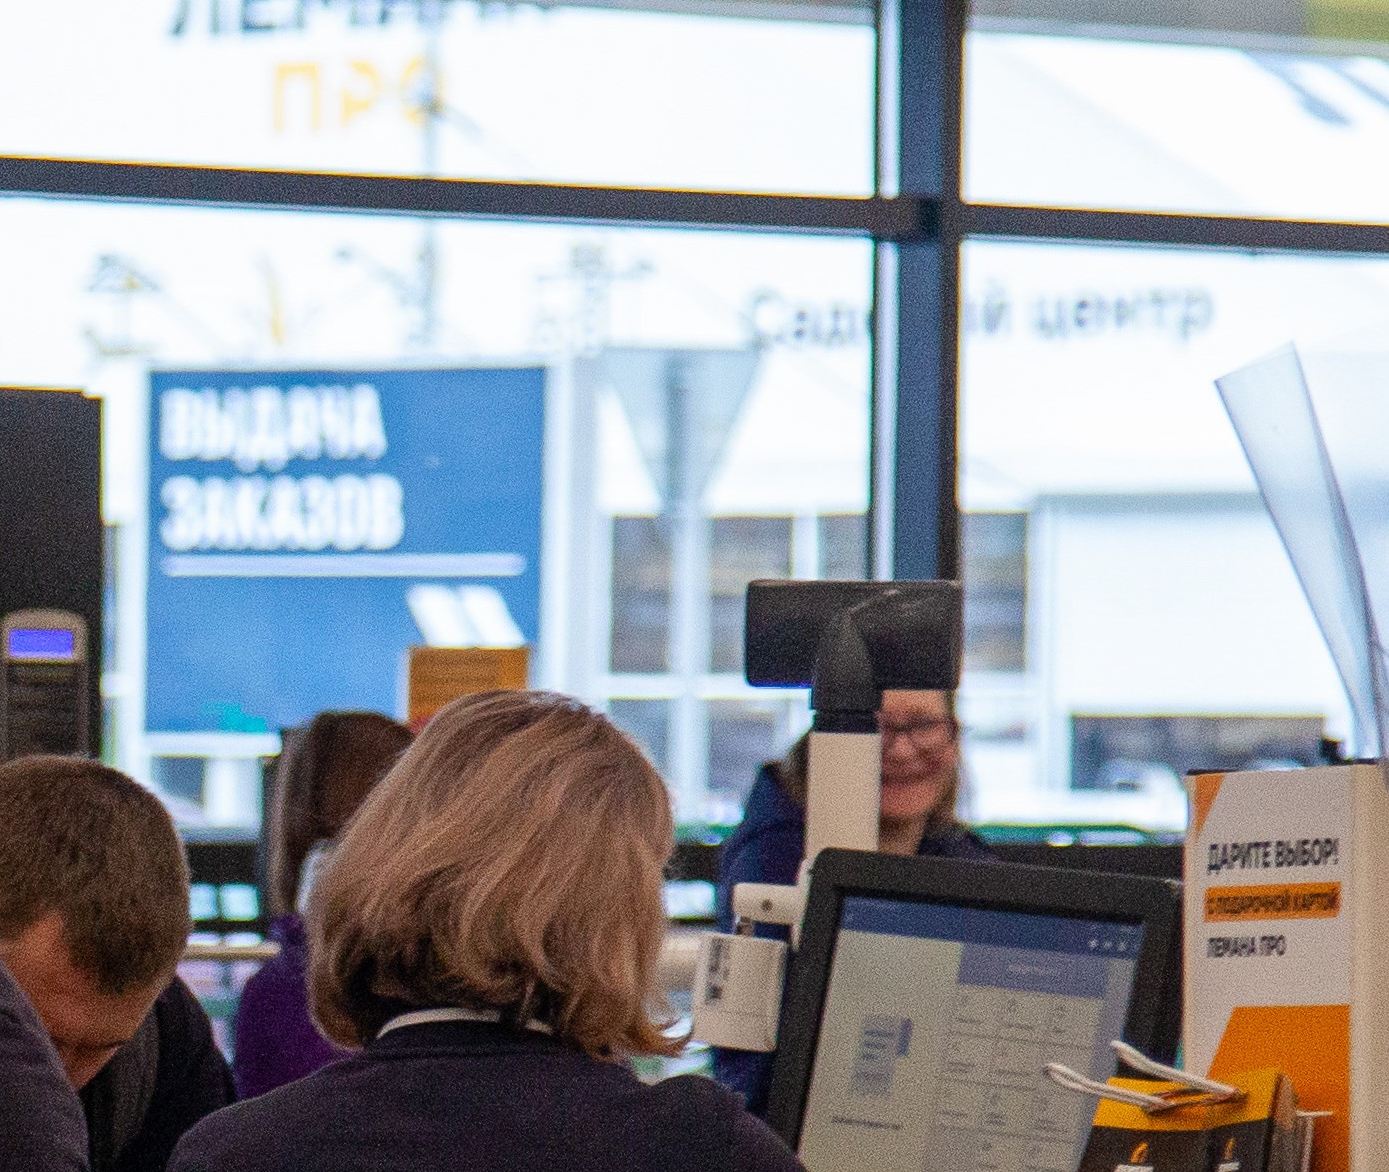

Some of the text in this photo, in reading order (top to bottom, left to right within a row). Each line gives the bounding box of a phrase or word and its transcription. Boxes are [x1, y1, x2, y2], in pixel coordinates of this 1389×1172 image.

[159, 382, 389, 474] ВЫДАЧА
[159, 474, 406, 553] ЗАКАЗОВ
[1207, 837, 1340, 875] ДАРИТЕ ВЫБОР!
